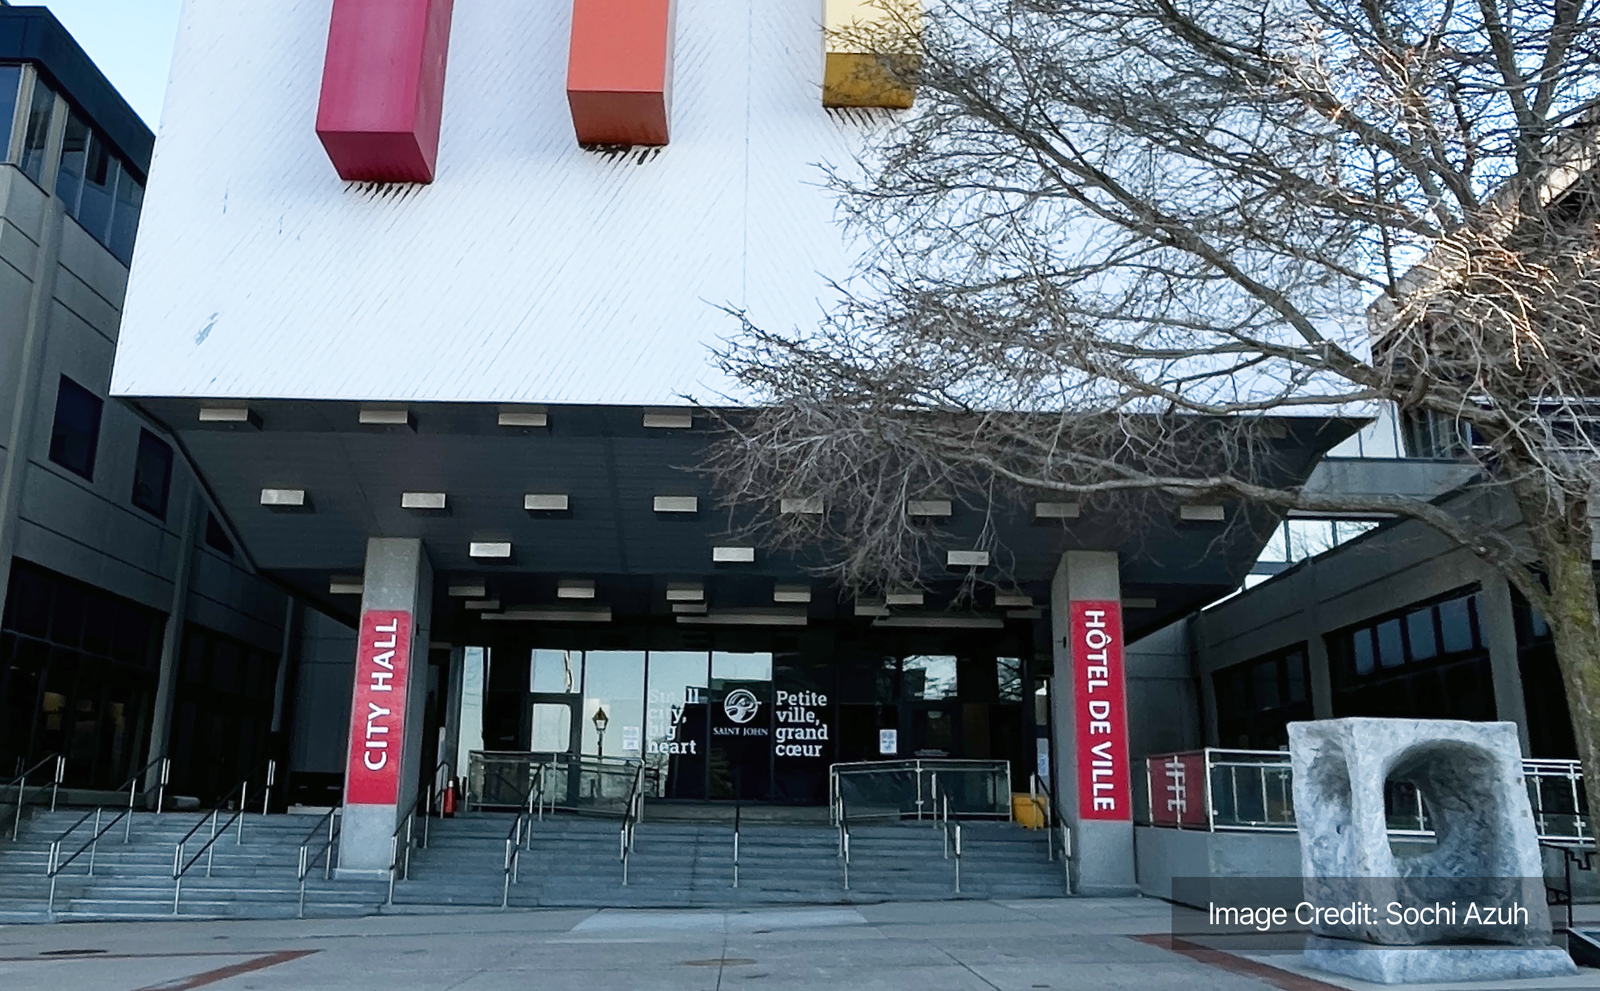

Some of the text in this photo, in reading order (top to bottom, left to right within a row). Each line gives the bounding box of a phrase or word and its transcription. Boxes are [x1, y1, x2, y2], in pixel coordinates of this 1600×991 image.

[364, 618, 397, 771] CITY HALL
[776, 691, 827, 706] Petite
[776, 707, 820, 726] ville,
[1084, 610, 1115, 811] HÔTEL DE VILLE
[713, 727, 768, 736] SAINT JOHN
[776, 724, 828, 743] grand
[647, 740, 697, 754] heart
